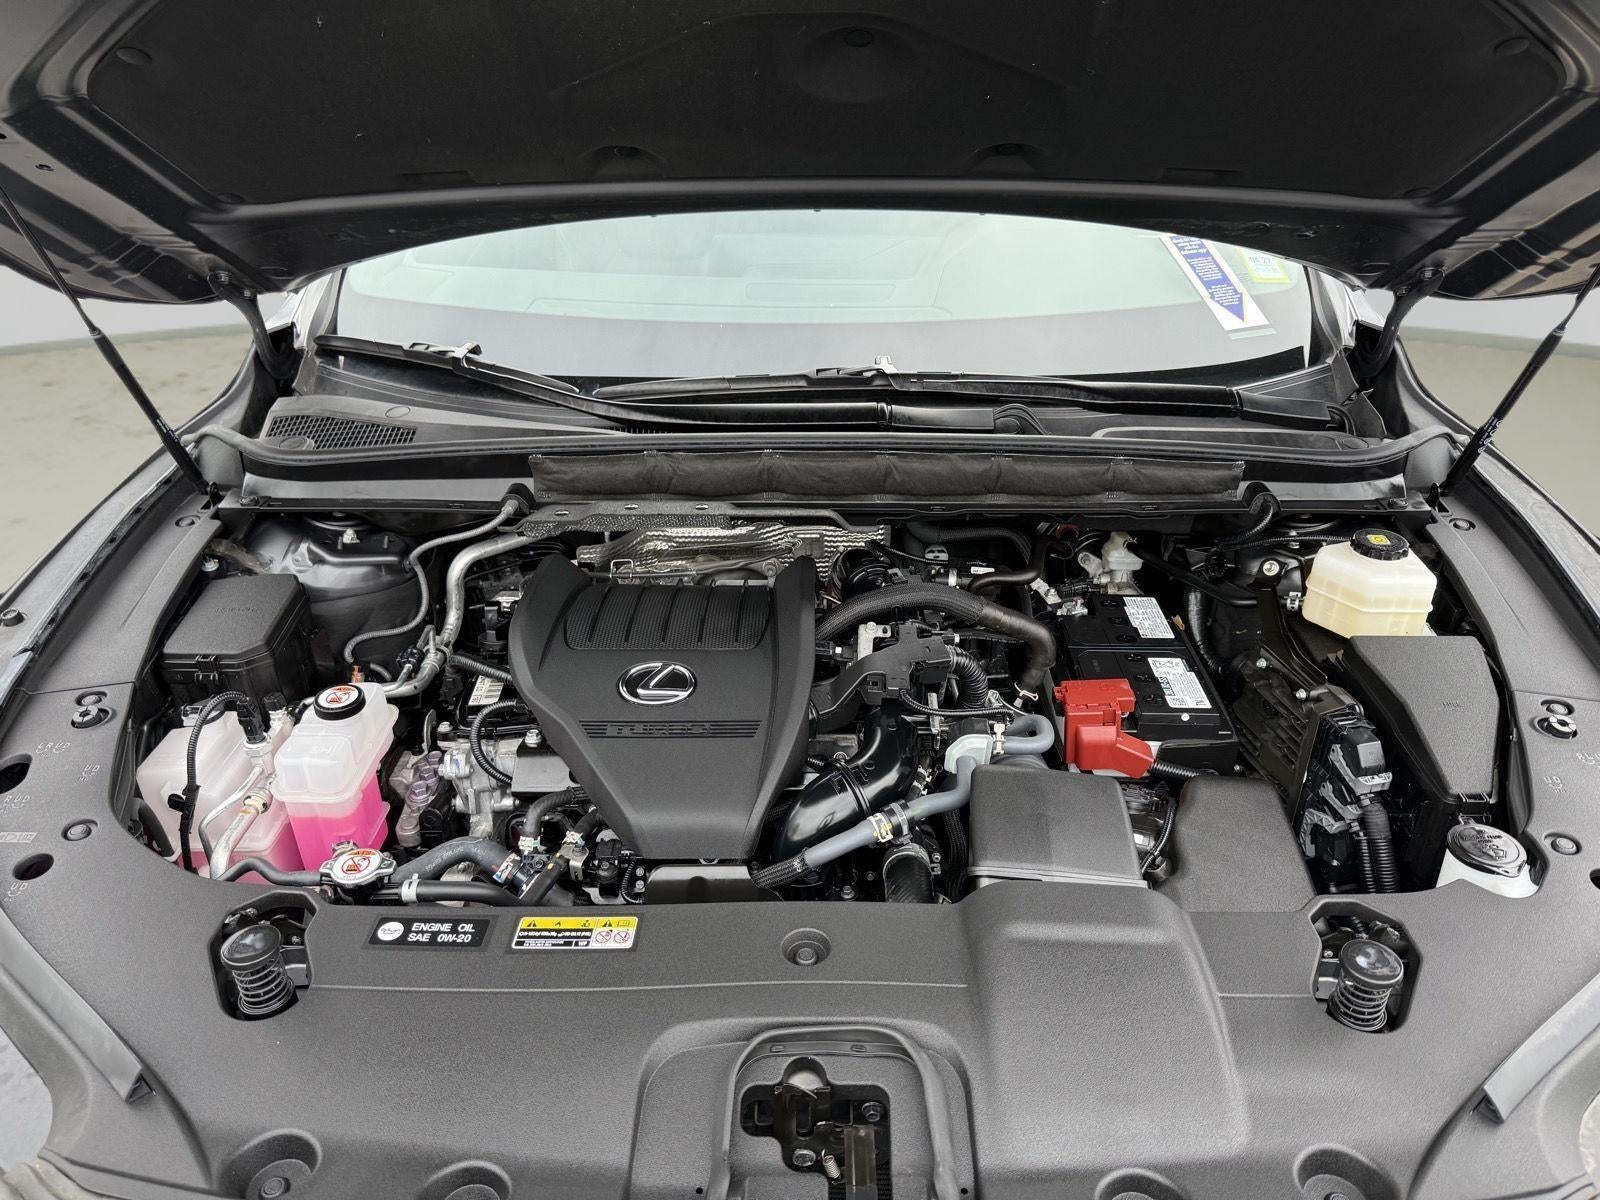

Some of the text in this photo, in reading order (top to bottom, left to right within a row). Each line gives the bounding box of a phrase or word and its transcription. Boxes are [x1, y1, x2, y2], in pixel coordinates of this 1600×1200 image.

[606, 723, 711, 736] TURBO
[411, 922, 476, 933] ENGINE OIL
[407, 933, 472, 943] SAE 0W-20
